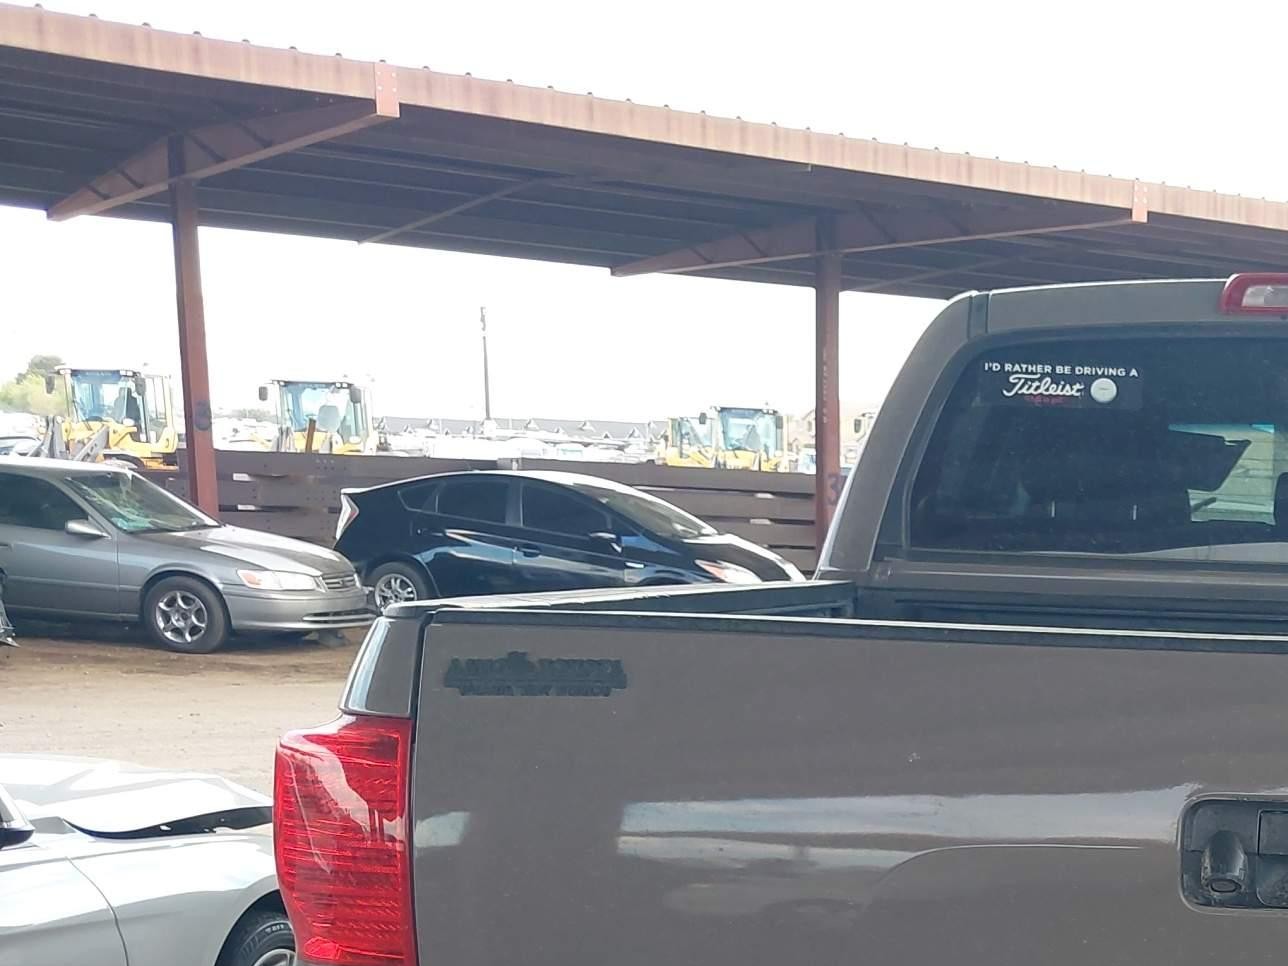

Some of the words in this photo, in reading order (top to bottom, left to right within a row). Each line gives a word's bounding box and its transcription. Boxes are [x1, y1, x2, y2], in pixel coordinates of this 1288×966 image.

[984, 361, 1001, 371] I'D
[1004, 362, 1052, 374] RATHER
[1055, 365, 1072, 375] BE
[1075, 366, 1126, 377] DRIVING
[1129, 368, 1139, 377] A
[1002, 373, 1085, 397] Titleist
